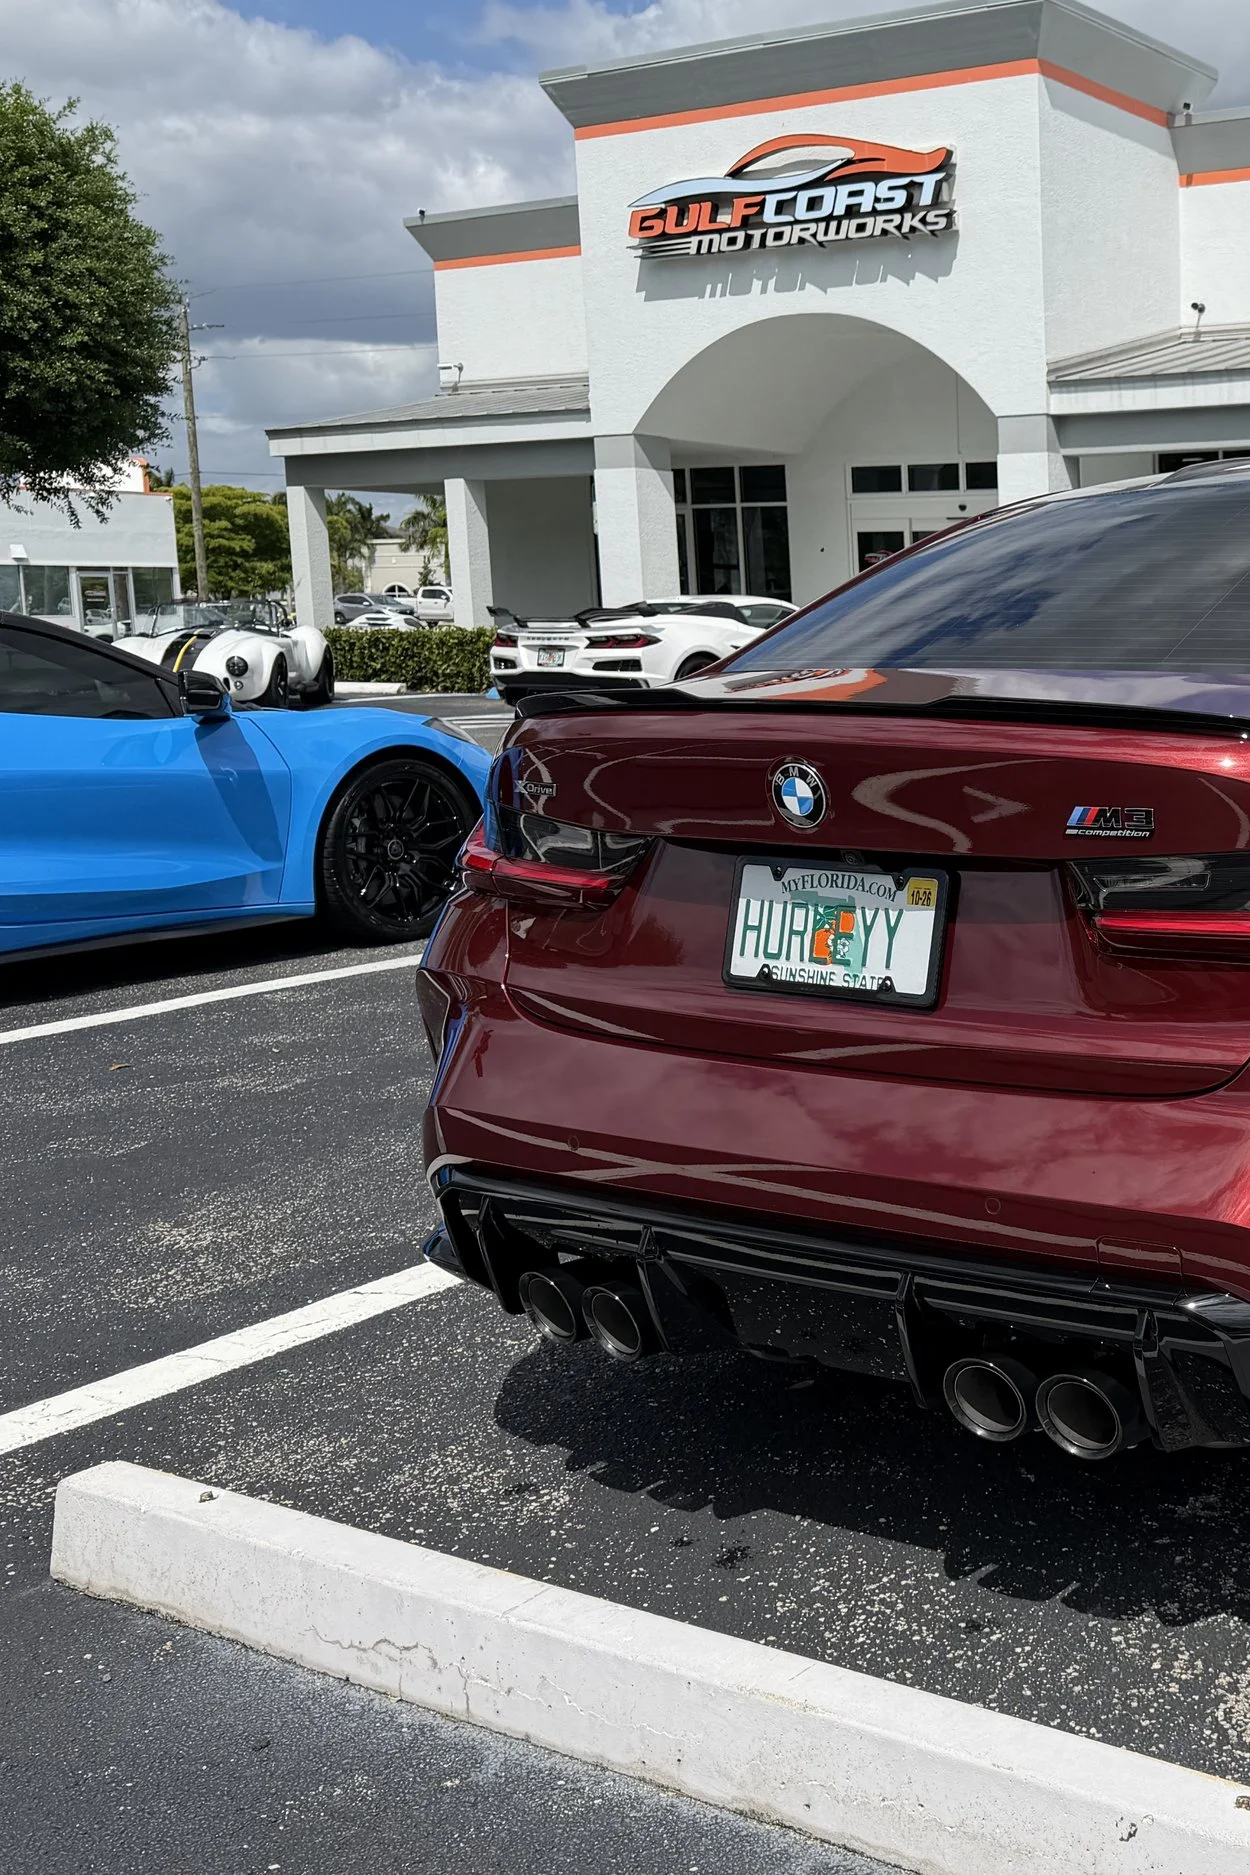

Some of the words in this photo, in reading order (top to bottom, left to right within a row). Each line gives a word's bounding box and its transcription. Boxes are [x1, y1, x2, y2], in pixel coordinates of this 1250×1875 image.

[628, 172, 947, 238] GULFCOAST
[689, 209, 952, 255] MOTORWORKS
[774, 766, 818, 788] BMW
[1078, 829, 1150, 837] competition
[781, 872, 899, 902] MYFLORIDA.COM
[911, 889, 932, 906] 10-26
[771, 965, 836, 985] SUNSHINE
